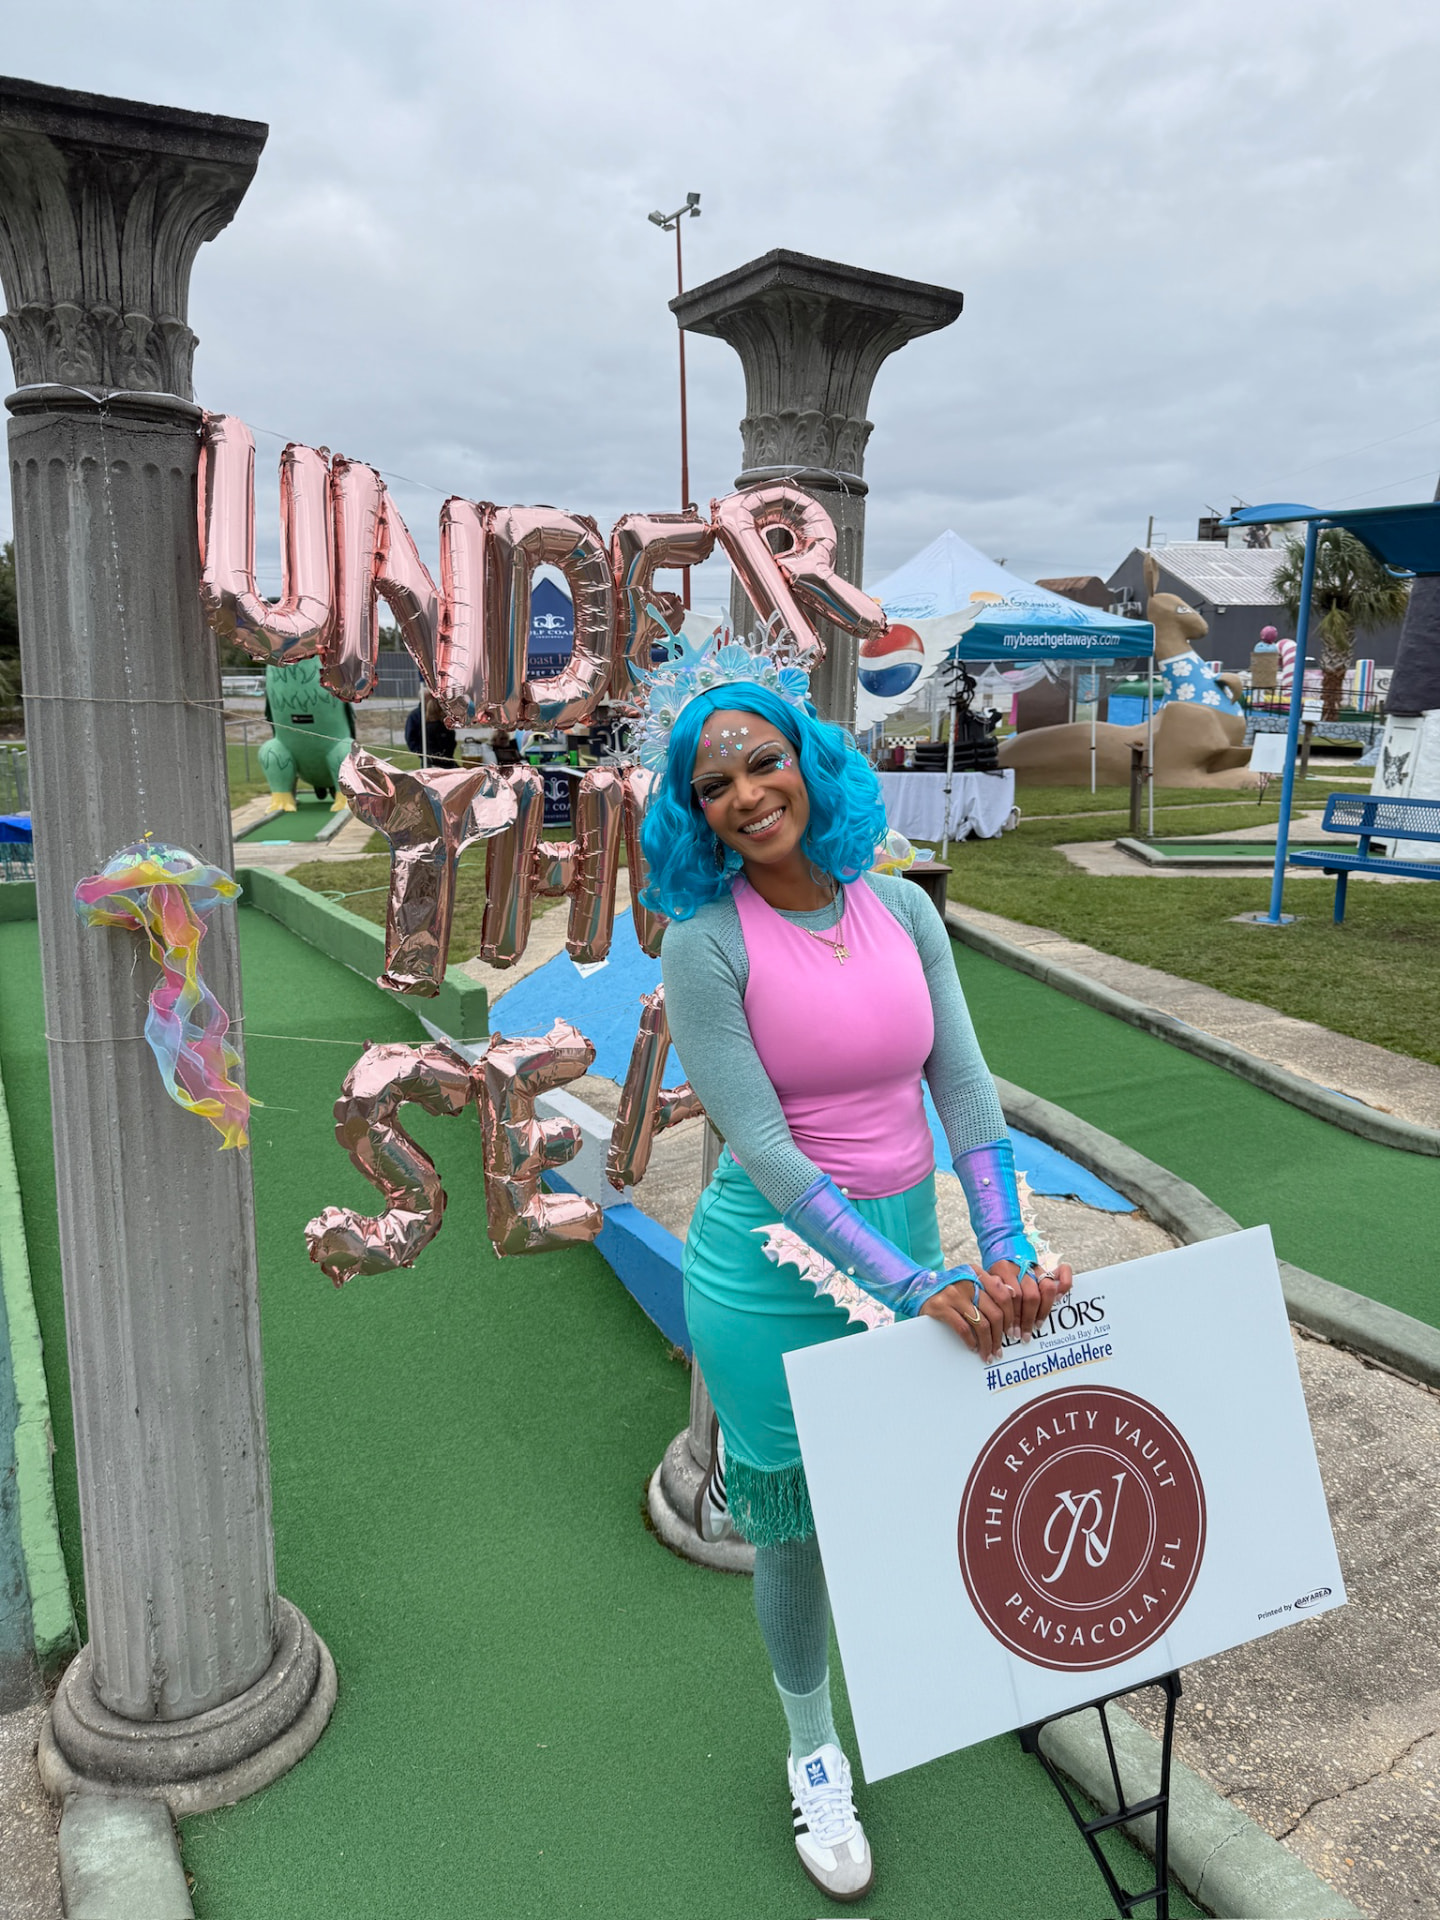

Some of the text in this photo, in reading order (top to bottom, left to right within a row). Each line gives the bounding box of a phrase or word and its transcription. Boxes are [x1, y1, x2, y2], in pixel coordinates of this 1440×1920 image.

[200, 411, 889, 730] UNDER
[1003, 631, 1121, 649] mybeachgetaways.com
[1039, 1323, 1111, 1349] Pensacola Bay Area
[986, 1342, 1113, 1391] #LeadersMadeHere
[985, 1410, 1176, 1549] THE REALTY VAULT
[1004, 1537, 1181, 1646] PENSACOLA, FL
[1257, 1606, 1283, 1620] Printed
[1284, 1604, 1292, 1612] by
